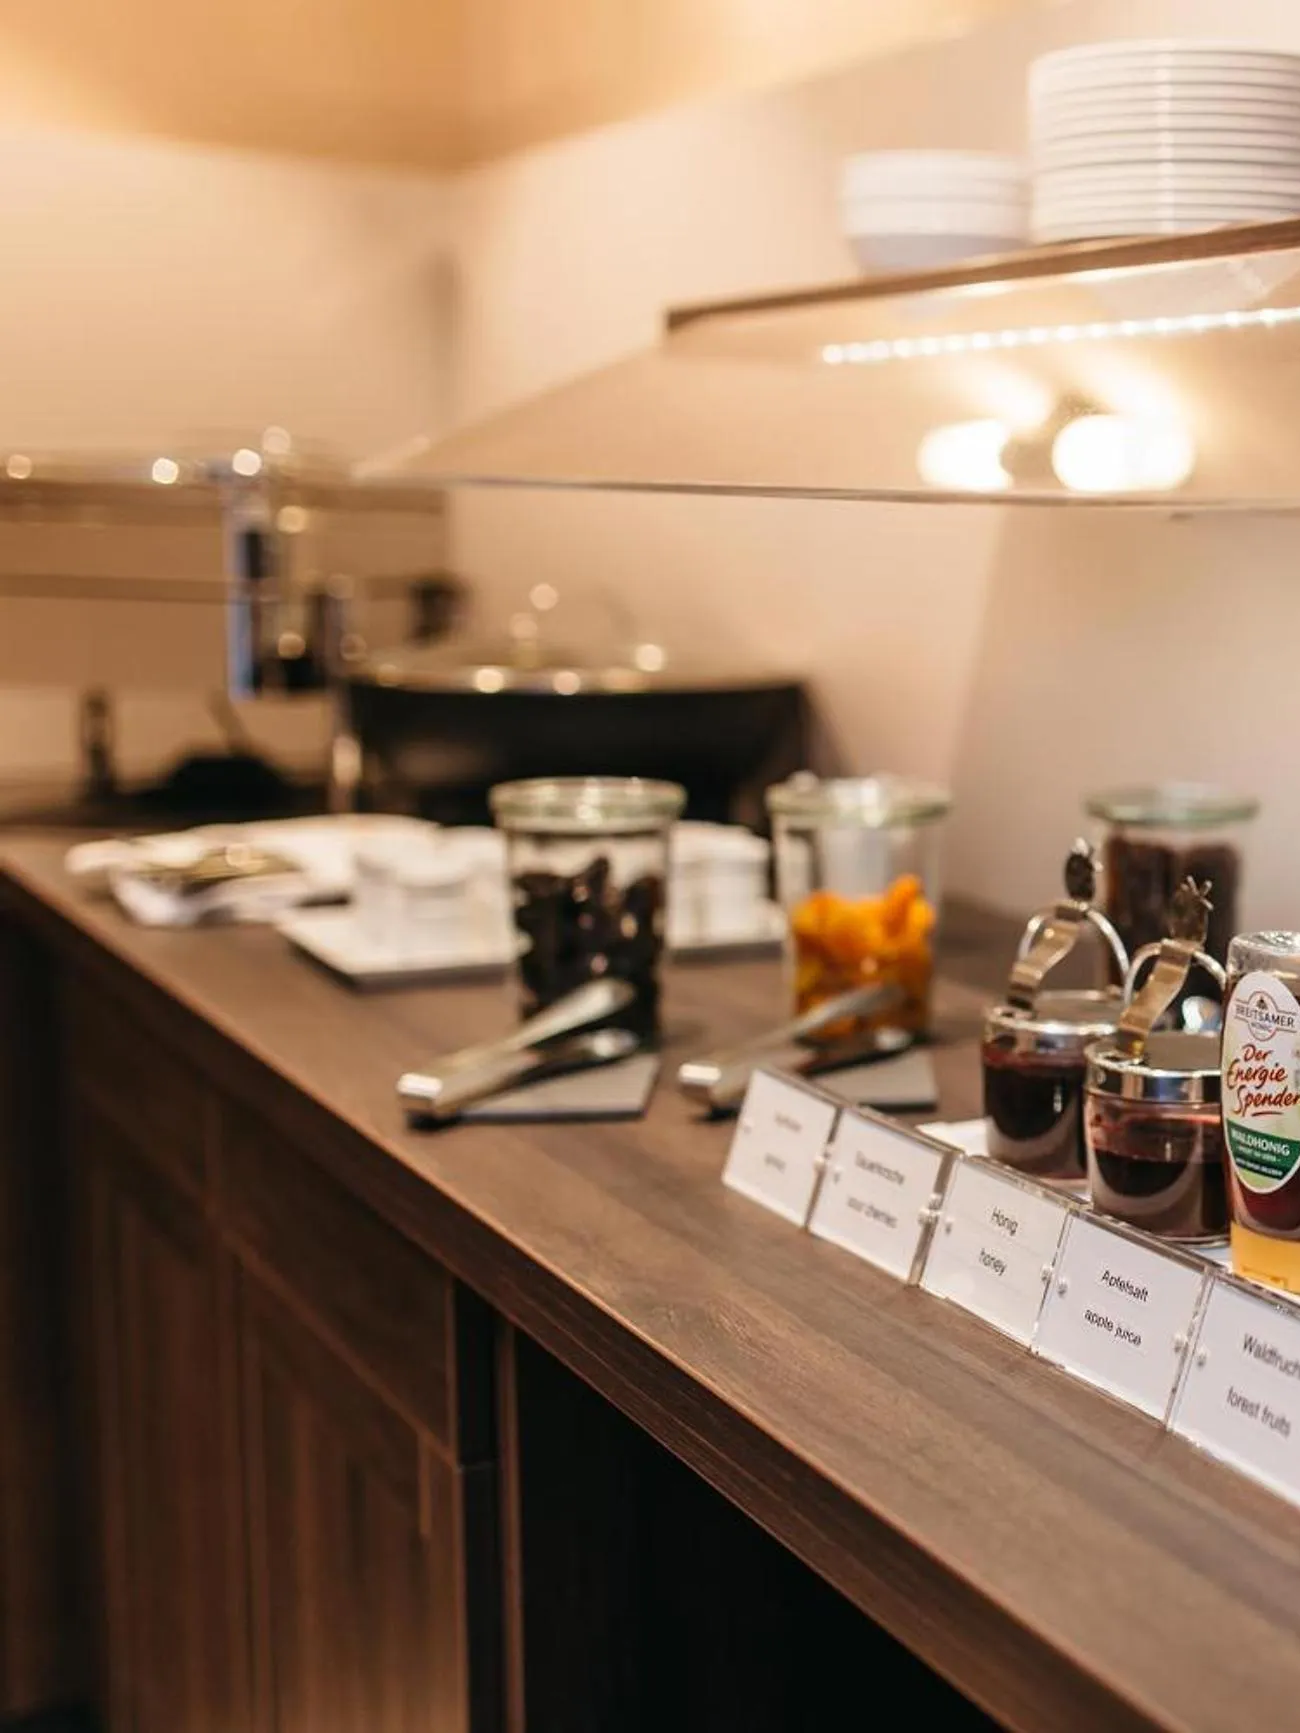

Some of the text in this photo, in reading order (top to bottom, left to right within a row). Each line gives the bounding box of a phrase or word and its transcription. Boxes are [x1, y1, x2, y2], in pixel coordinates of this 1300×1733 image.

[1235, 1003, 1295, 1028] BREITSAMER
[1242, 1043, 1274, 1062] Der
[1227, 1058, 1288, 1089] Energie
[1231, 1127, 1290, 1156] WALDHONIG
[991, 1206, 1019, 1236] Honig
[980, 1248, 1007, 1276] honey
[1100, 1269, 1149, 1302] Apfelsaft
[1084, 1308, 1142, 1347] apple juice
[1226, 1385, 1291, 1438] forest fruits
